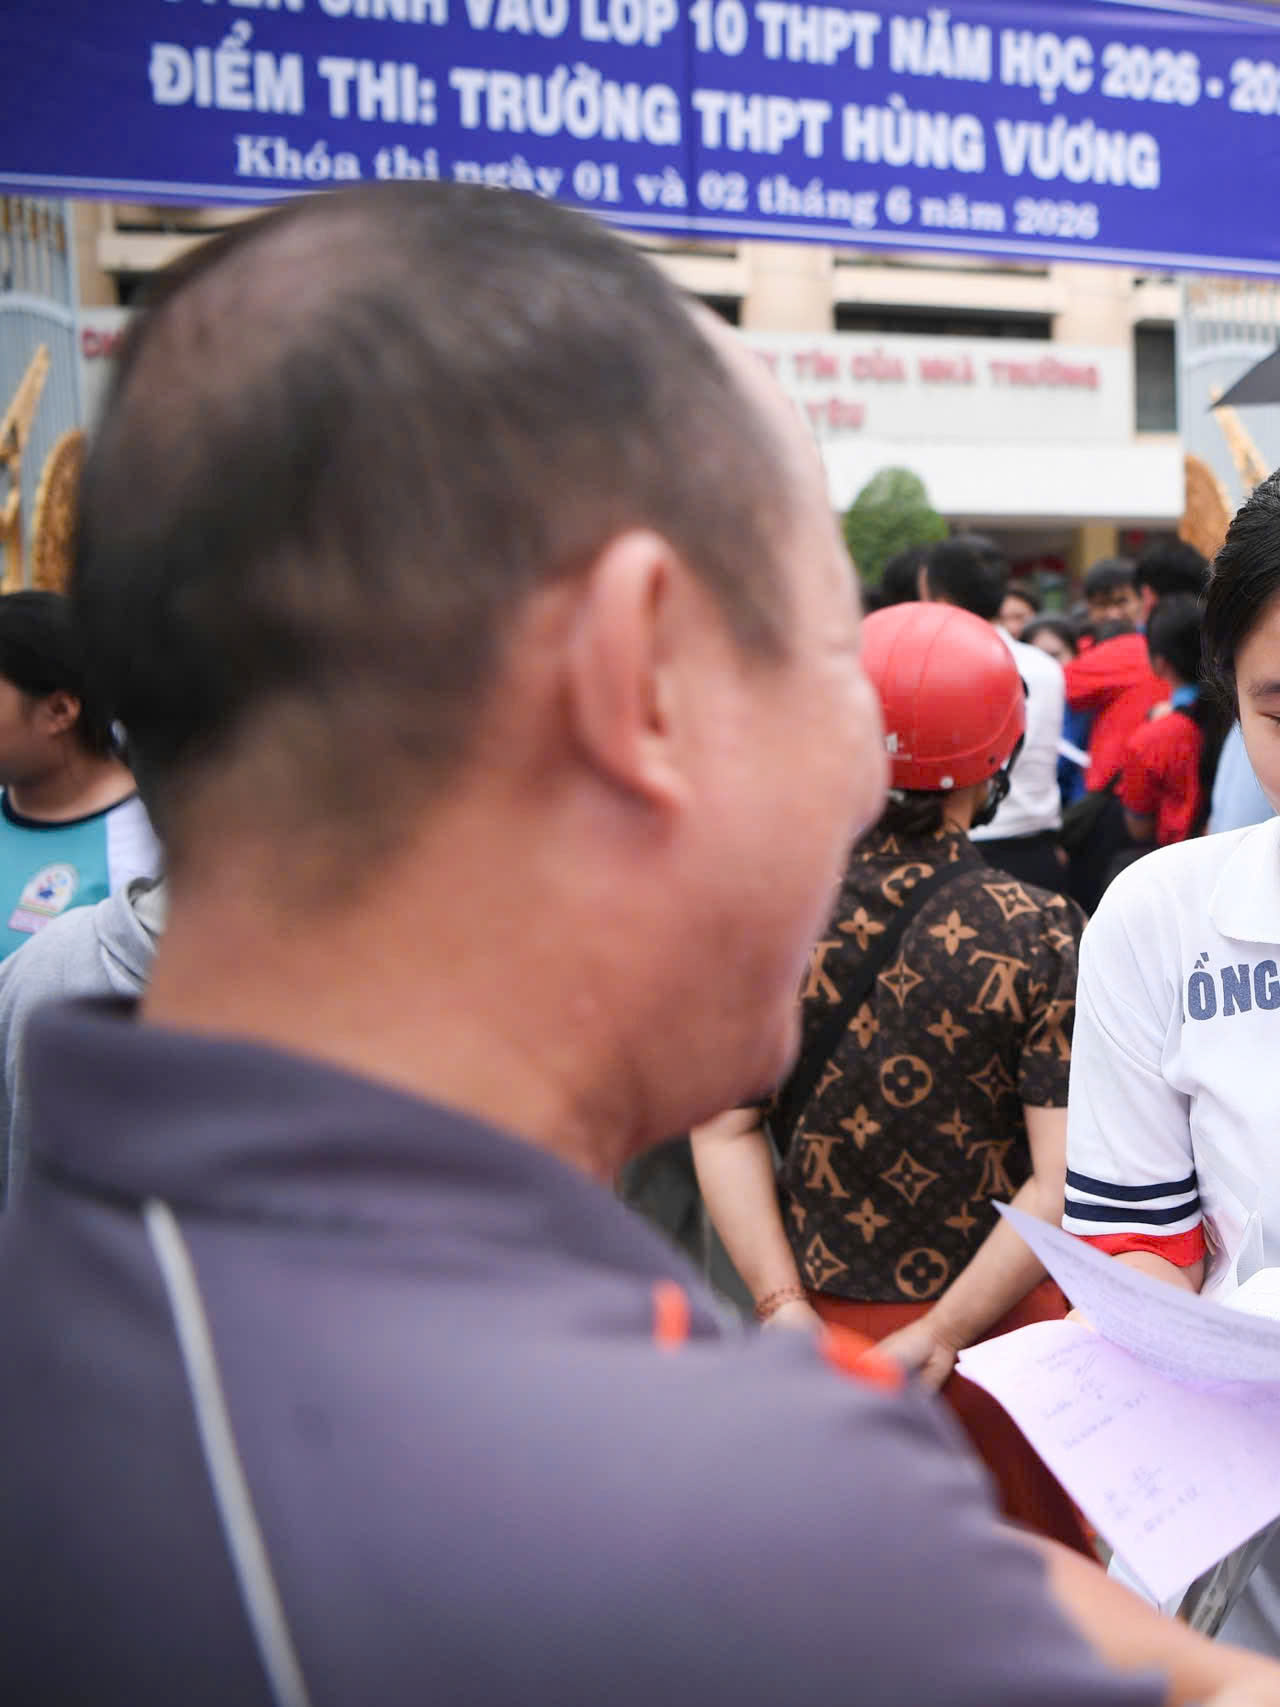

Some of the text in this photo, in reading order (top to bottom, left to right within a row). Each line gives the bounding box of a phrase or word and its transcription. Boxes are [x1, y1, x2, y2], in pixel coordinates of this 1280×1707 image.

[149, 19, 1161, 190] ĐIỂM THI: TRƯỜNG THPT HÙNG VƯƠNG
[689, 0, 749, 56] 10
[755, 2, 881, 69] THPT
[889, 8, 992, 82] NĂM
[1000, 29, 1094, 104] HỌC
[1101, 41, 1200, 106] 2026
[234, 134, 362, 181] Khóa
[374, 145, 440, 182] thi
[572, 160, 623, 203] 01
[634, 165, 689, 208] và
[698, 169, 750, 212] 02
[757, 174, 879, 229] tháng
[885, 185, 913, 225] 6
[920, 192, 1006, 232] năm
[1013, 196, 1099, 240] 2026
